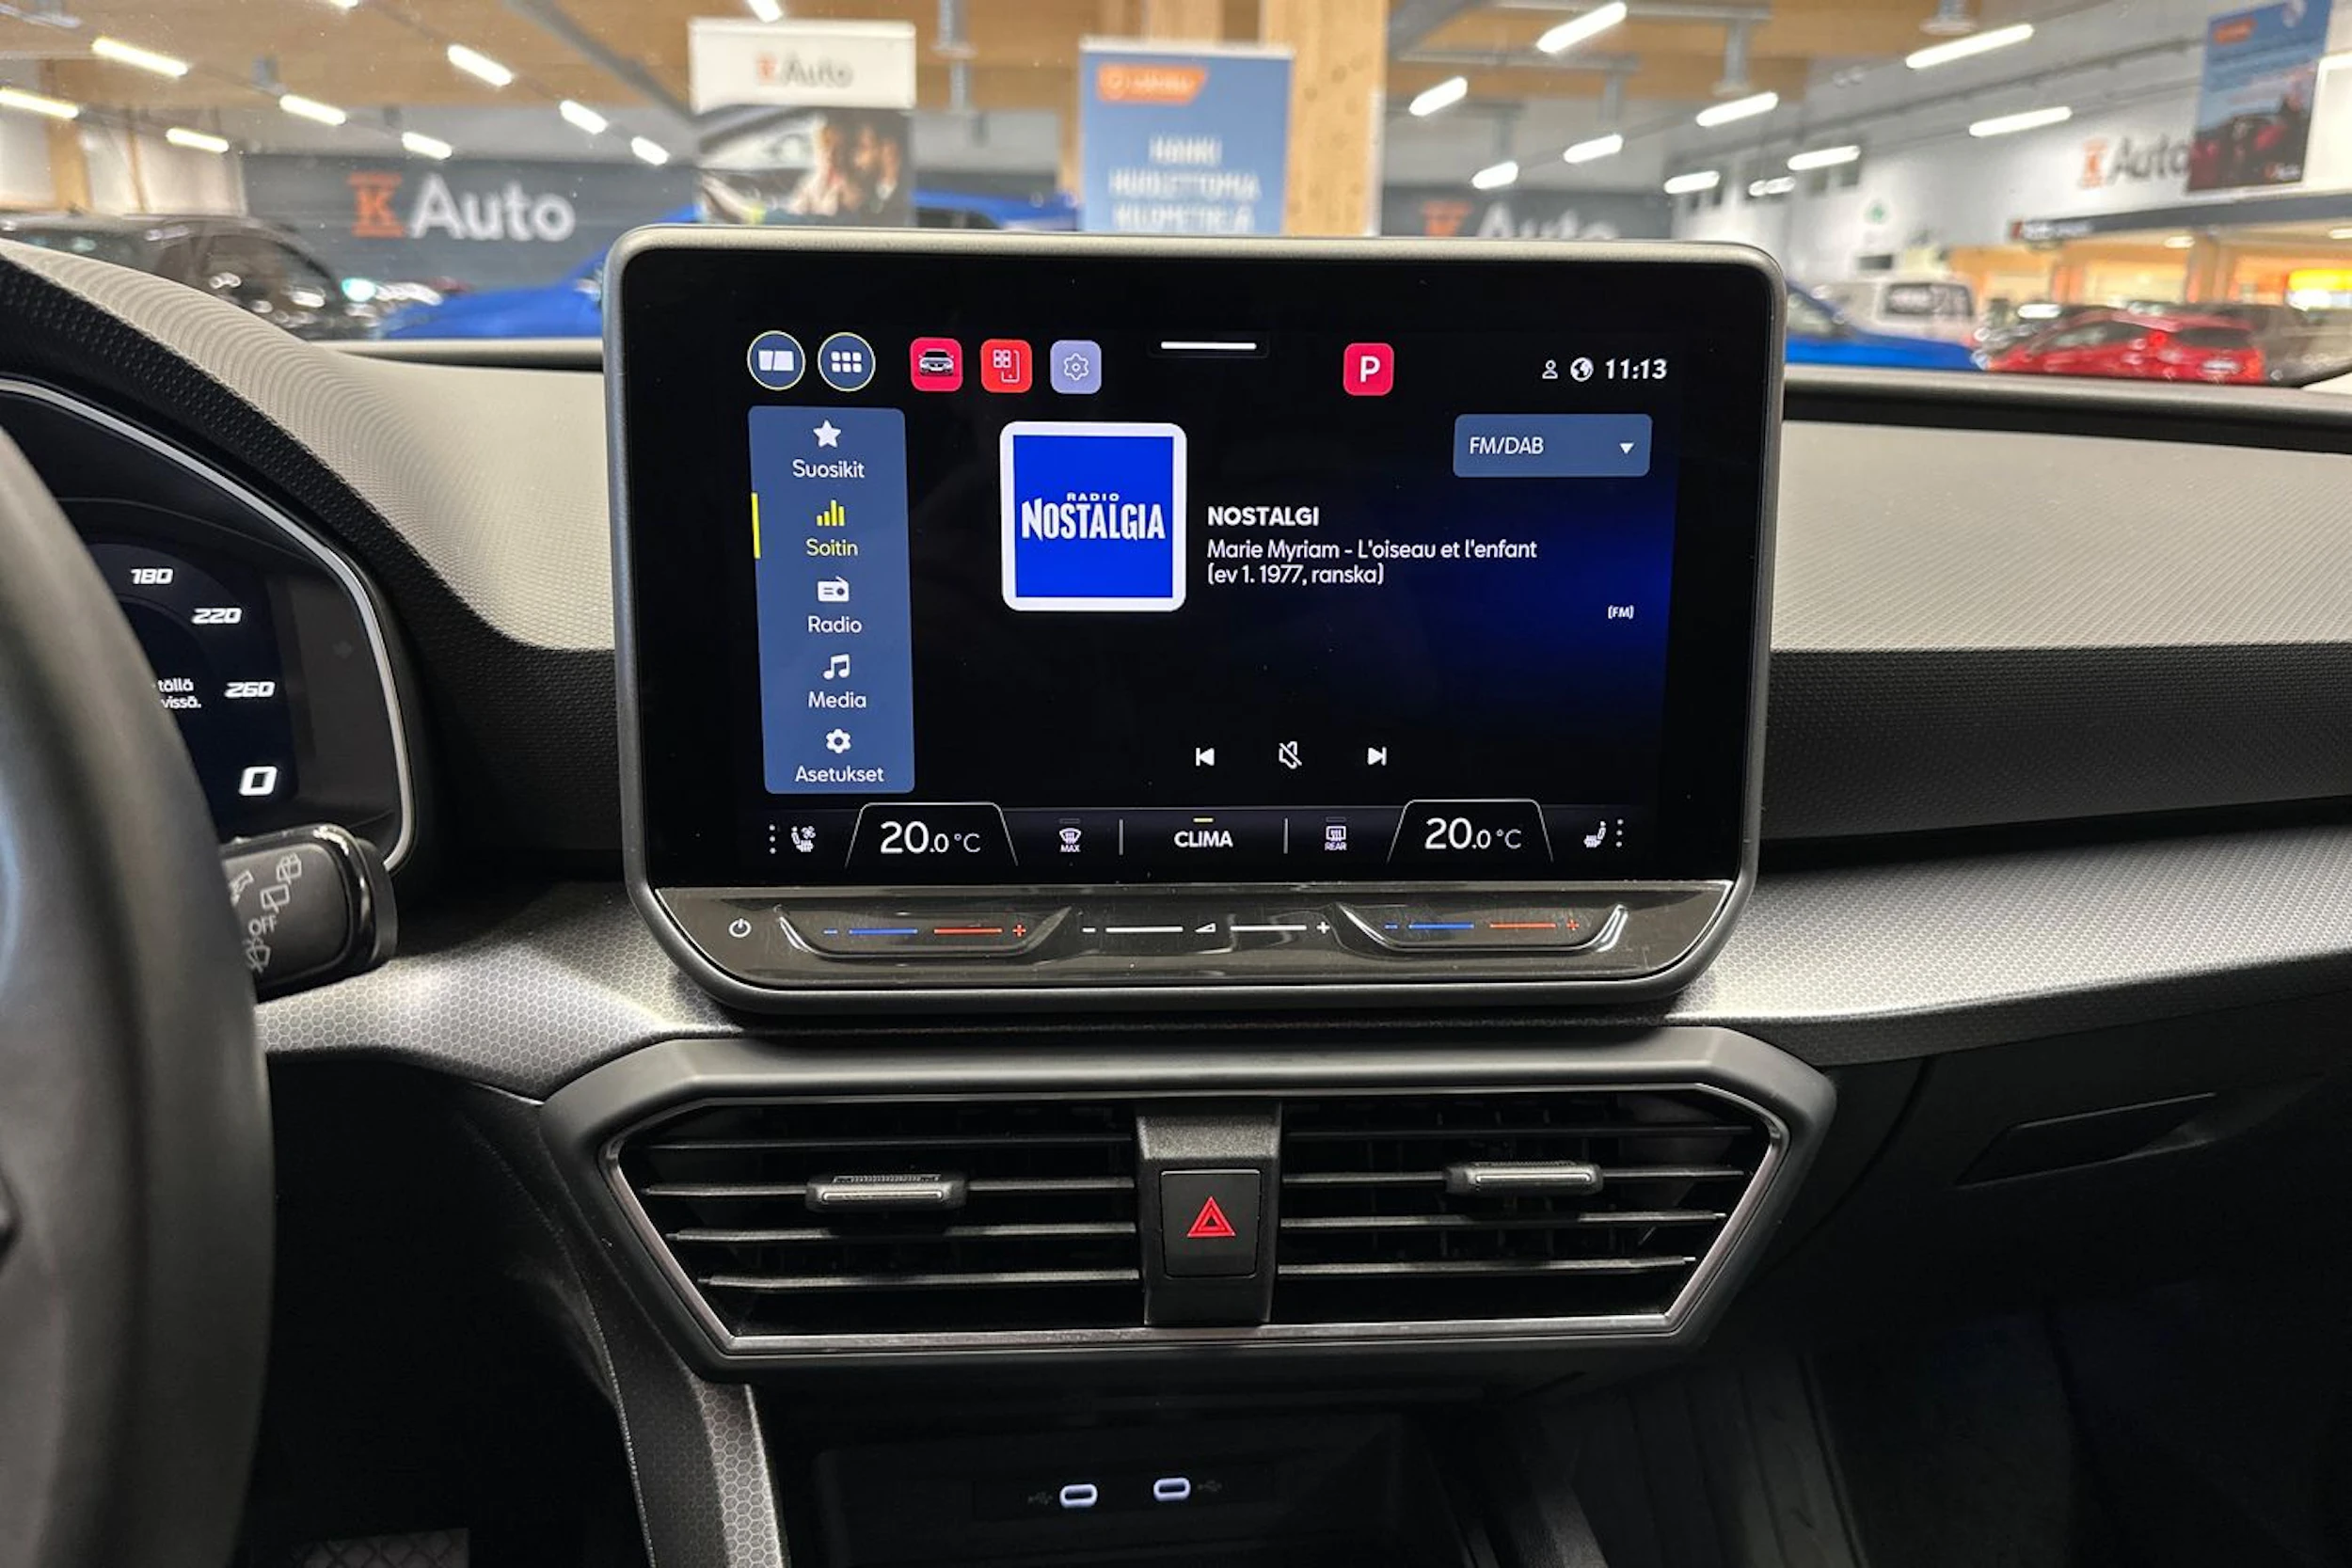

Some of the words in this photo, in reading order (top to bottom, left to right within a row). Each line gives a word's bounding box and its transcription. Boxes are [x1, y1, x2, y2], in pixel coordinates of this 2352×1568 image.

[347, 173, 404, 237] K
[408, 174, 576, 241] Auto
[1605, 358, 1668, 380] 11:13
[1470, 437, 1544, 455] FM/DAB
[792, 459, 866, 479] Suosikit
[1067, 492, 1120, 501] RADIO
[1021, 498, 1166, 542] NOSTALGIA
[1208, 507, 1319, 526] NOSTALGI
[805, 538, 858, 557] Soitin
[1208, 540, 1263, 559] Marie
[1267, 540, 1340, 563] Myriam
[1359, 541, 1437, 559] L'oiseau
[1440, 543, 1461, 559] et
[1465, 540, 1537, 560] l'enfant
[131, 568, 173, 585] 180
[1208, 565, 1238, 585] (ev
[1242, 566, 1255, 583] 1.
[1260, 566, 1308, 586] 1977,
[1311, 566, 1384, 585] ranska)
[192, 608, 243, 625] 220
[807, 616, 863, 633] Radio
[224, 681, 276, 698] 260
[808, 691, 866, 708] Media
[239, 766, 278, 797] 0
[795, 766, 884, 783] Asetukset
[1174, 831, 1233, 848] CLIMA
[1325, 842, 1347, 851] REAR
[248, 914, 277, 936] OFF
